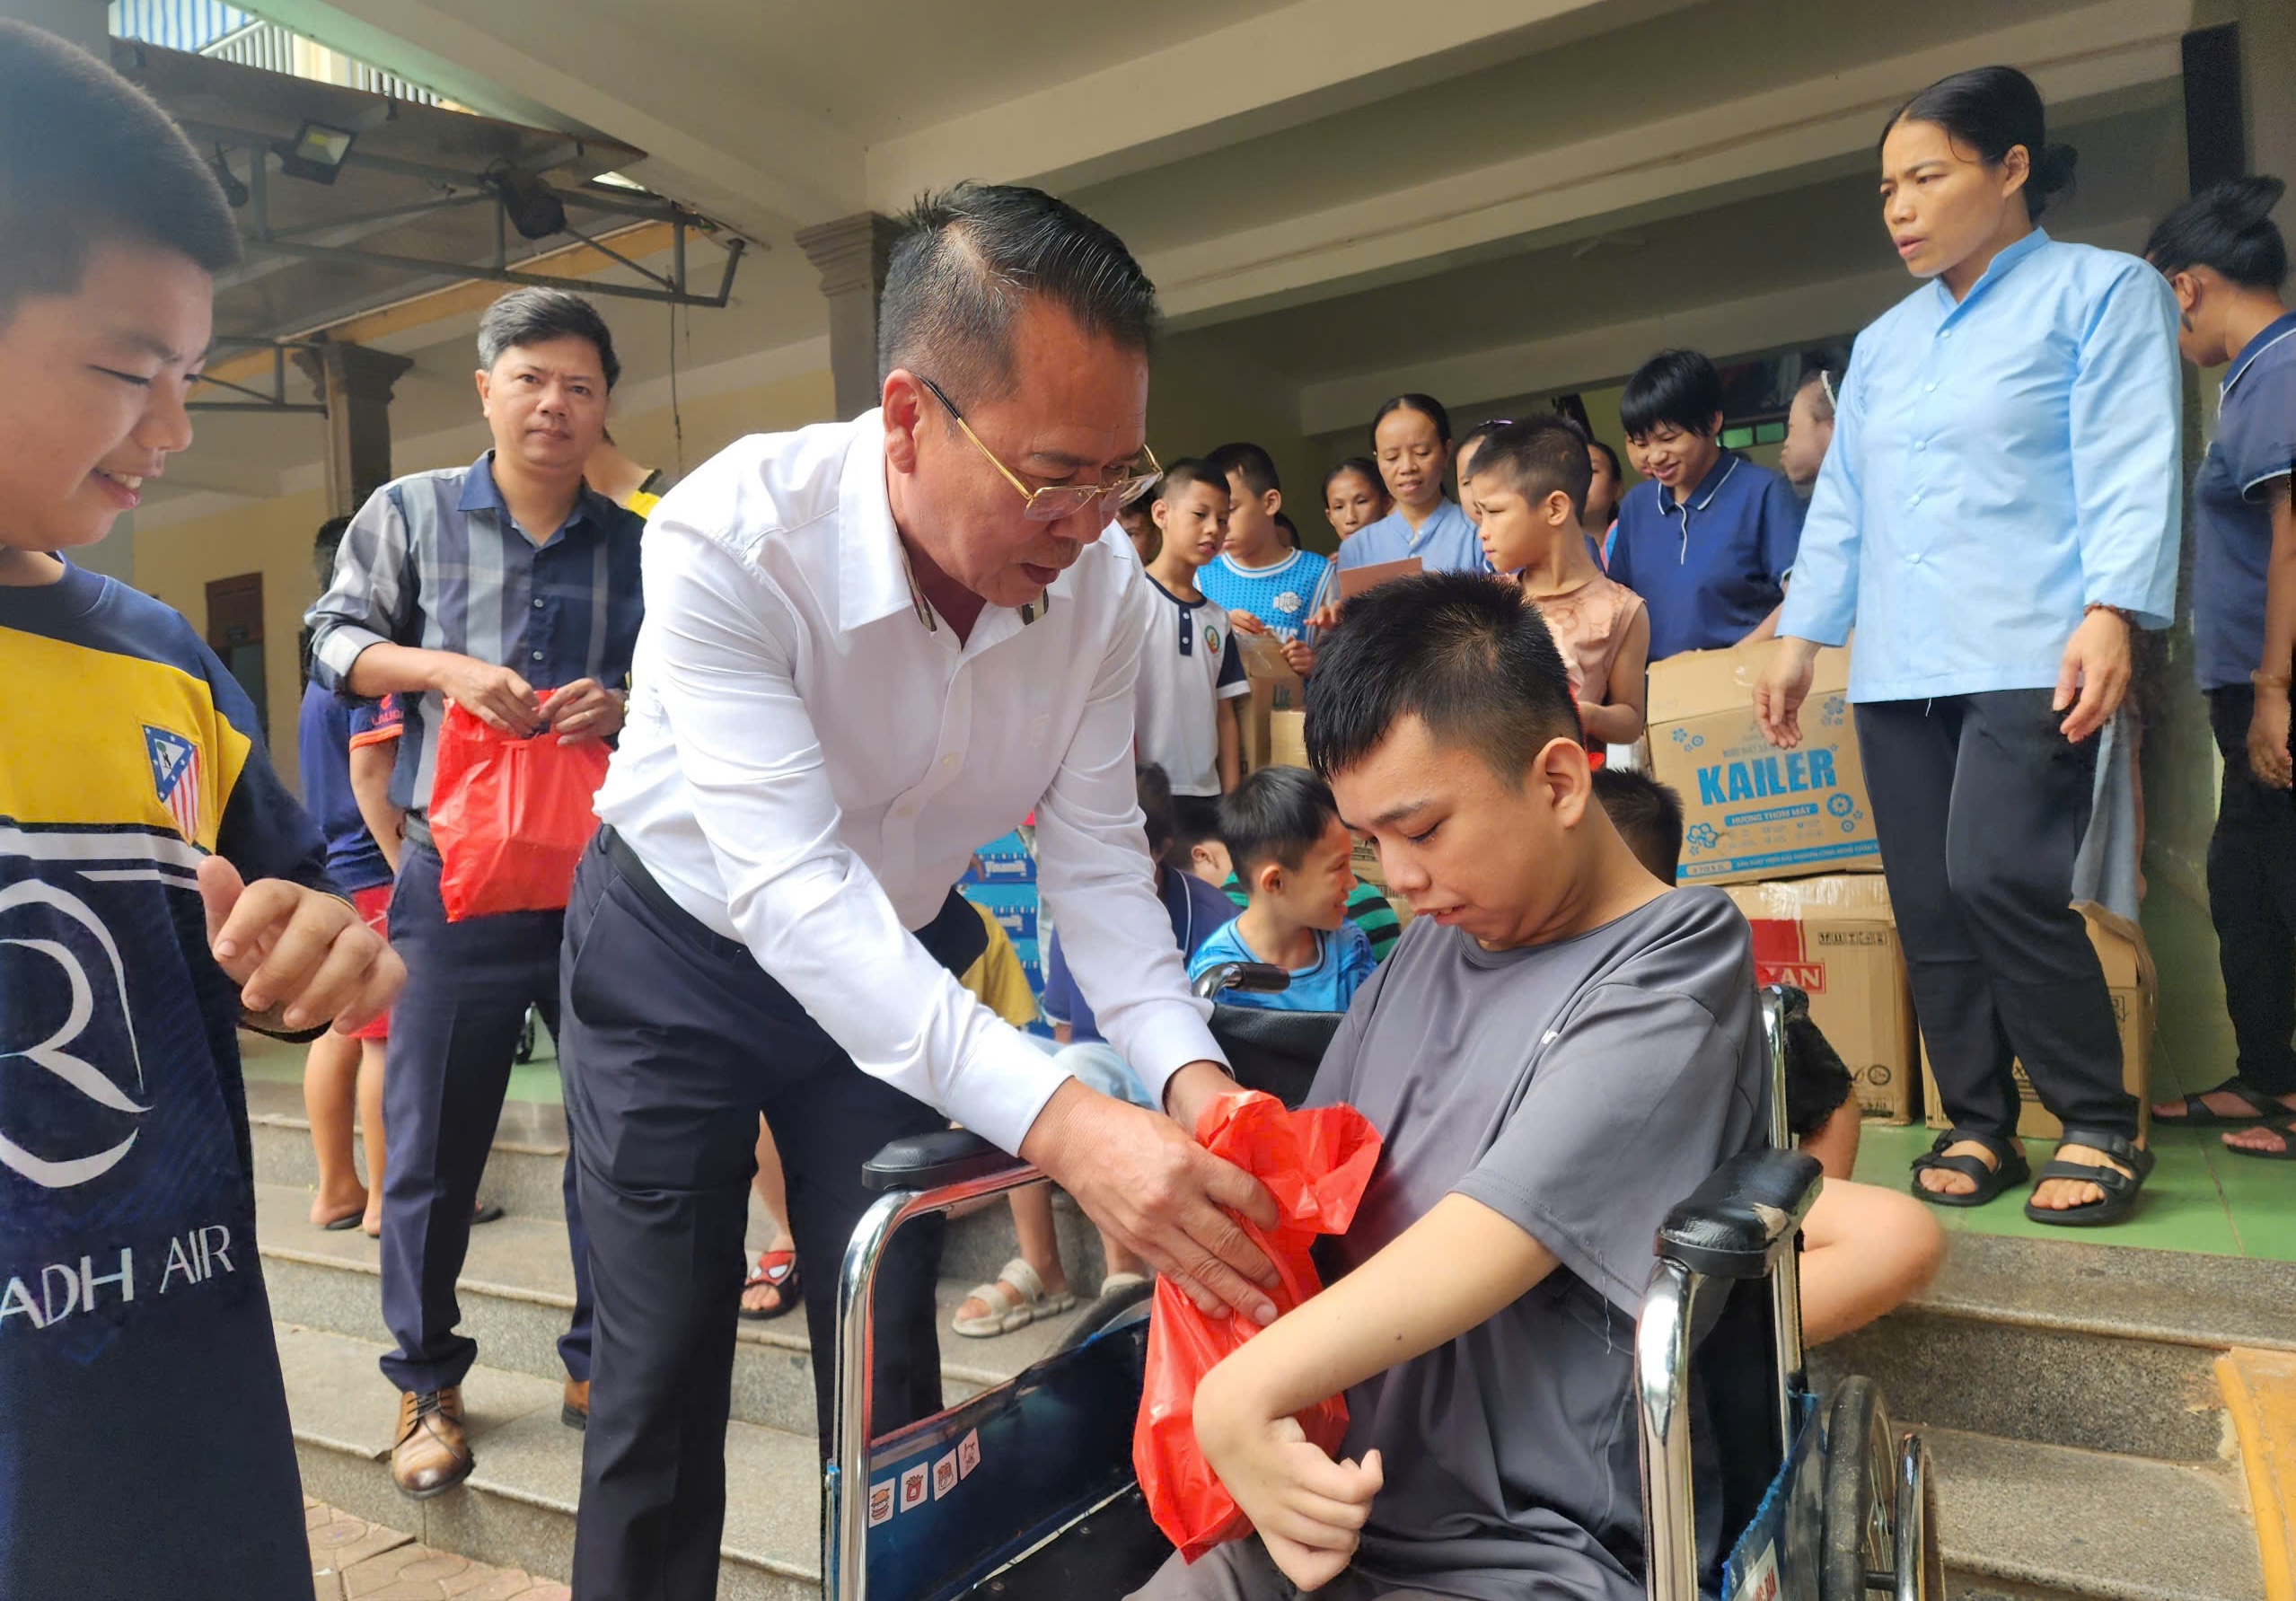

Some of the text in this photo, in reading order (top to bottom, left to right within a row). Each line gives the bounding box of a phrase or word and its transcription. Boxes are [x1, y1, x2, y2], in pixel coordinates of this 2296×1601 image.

[1697, 748, 1837, 805] KAILER
[0, 1225, 235, 1330] ADH AIR
